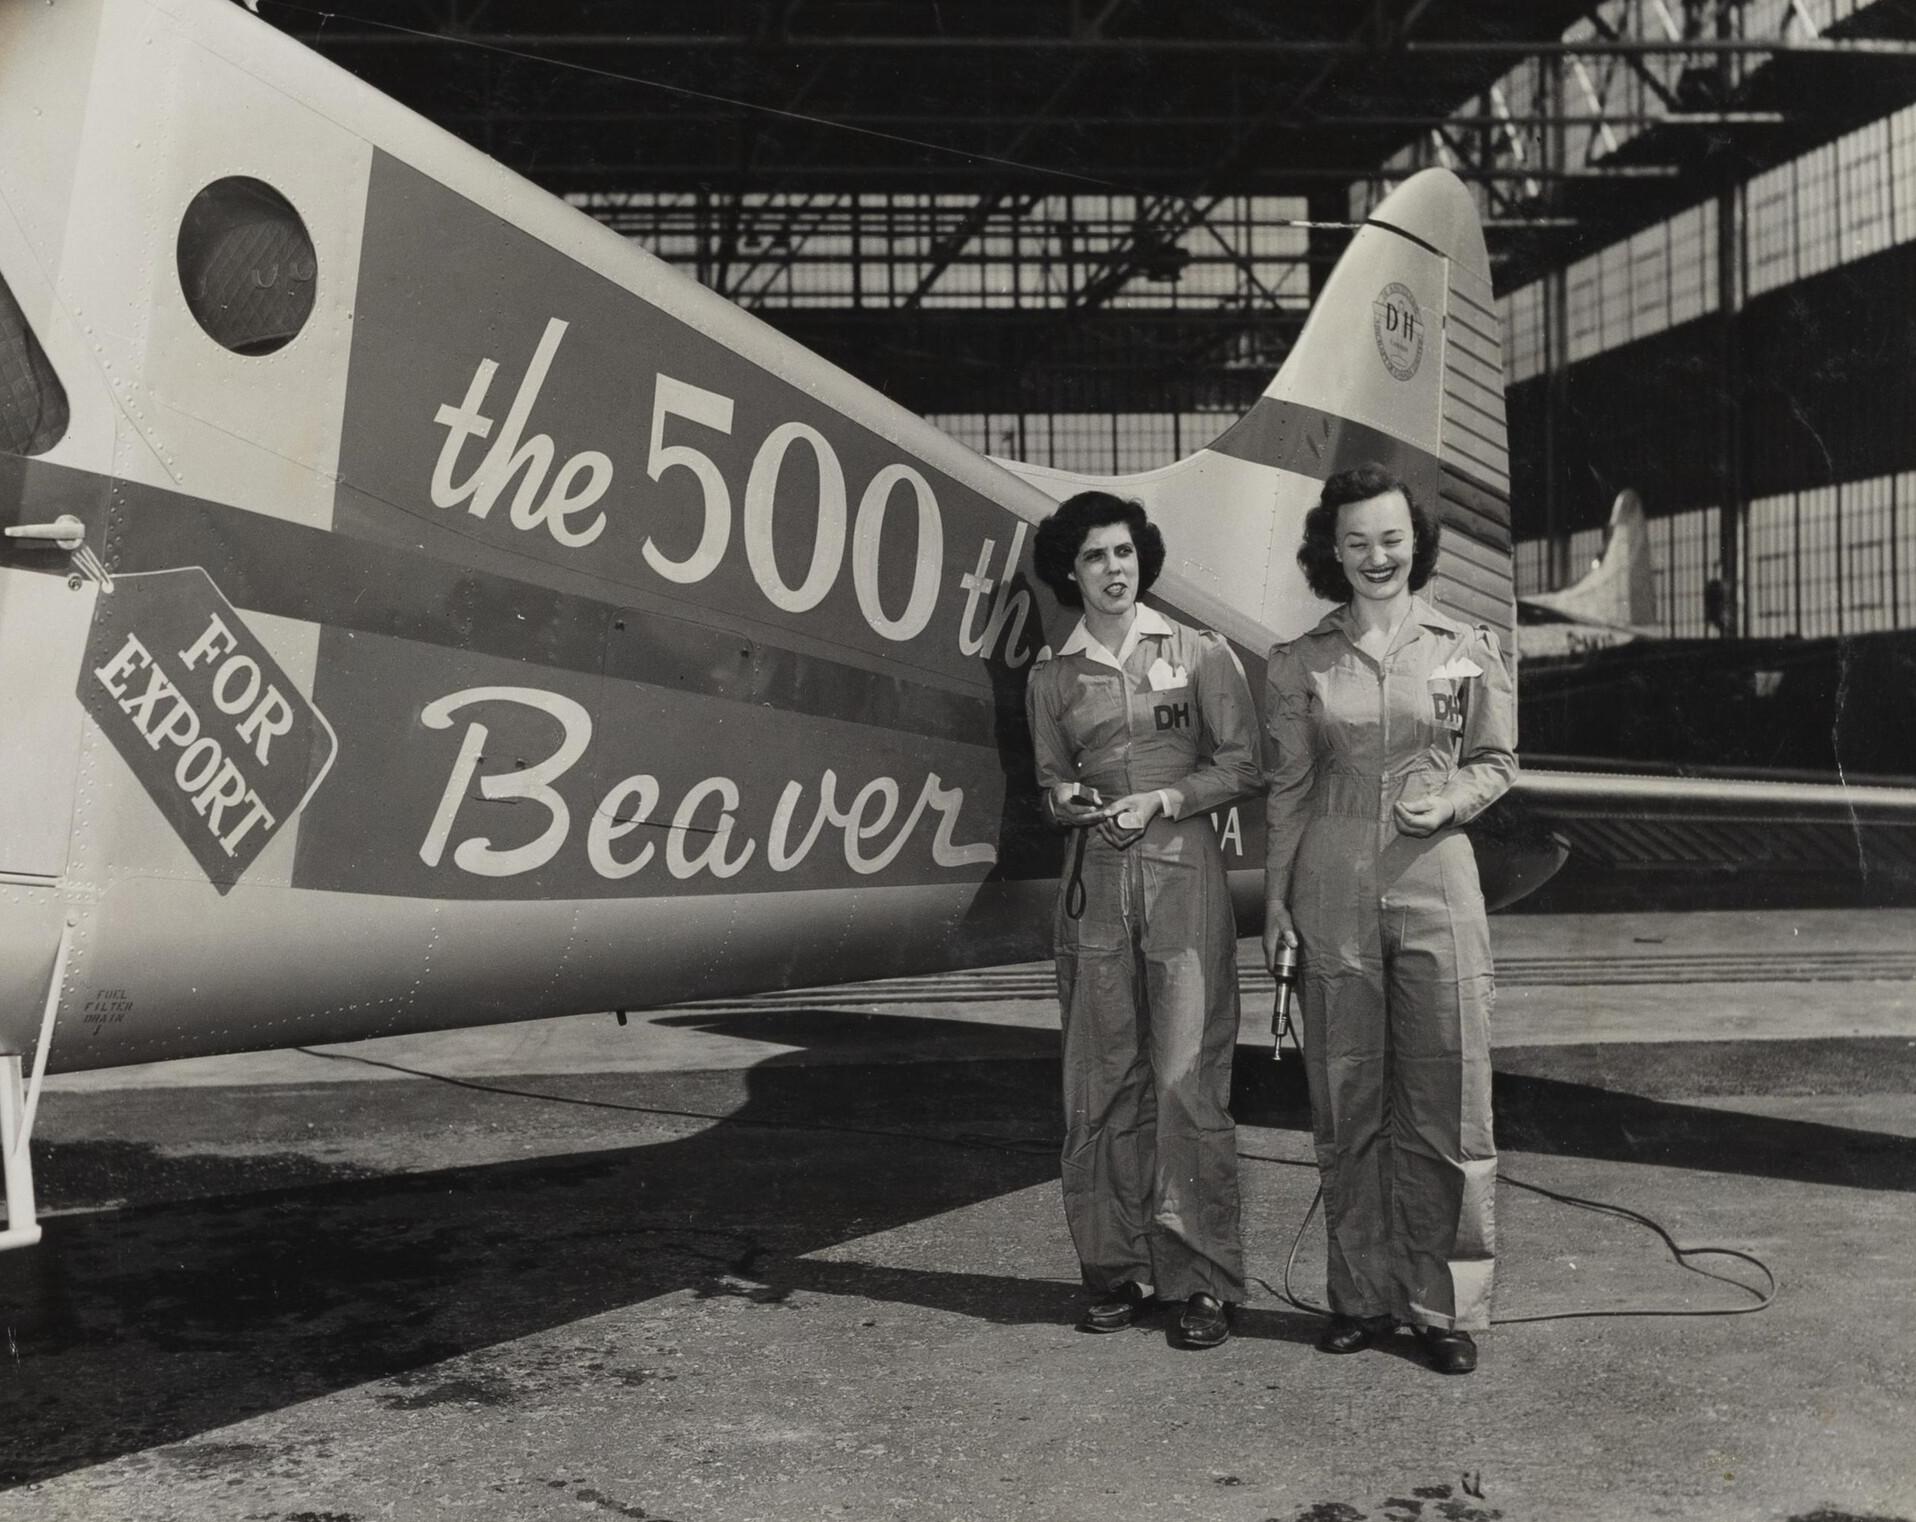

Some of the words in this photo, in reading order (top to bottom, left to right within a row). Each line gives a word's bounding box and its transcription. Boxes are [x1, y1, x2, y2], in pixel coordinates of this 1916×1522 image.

[430, 317, 613, 548] the
[641, 372, 944, 641] 500
[179, 612, 294, 767] FOR
[1153, 702, 1190, 731] DH
[1432, 692, 1460, 723] DH
[94, 633, 276, 858] EXPORT
[419, 685, 997, 879] Beaver
[83, 1001, 134, 1012] FILTER
[96, 989, 127, 1000] FUEL
[83, 1014, 126, 1023] DRAIN
